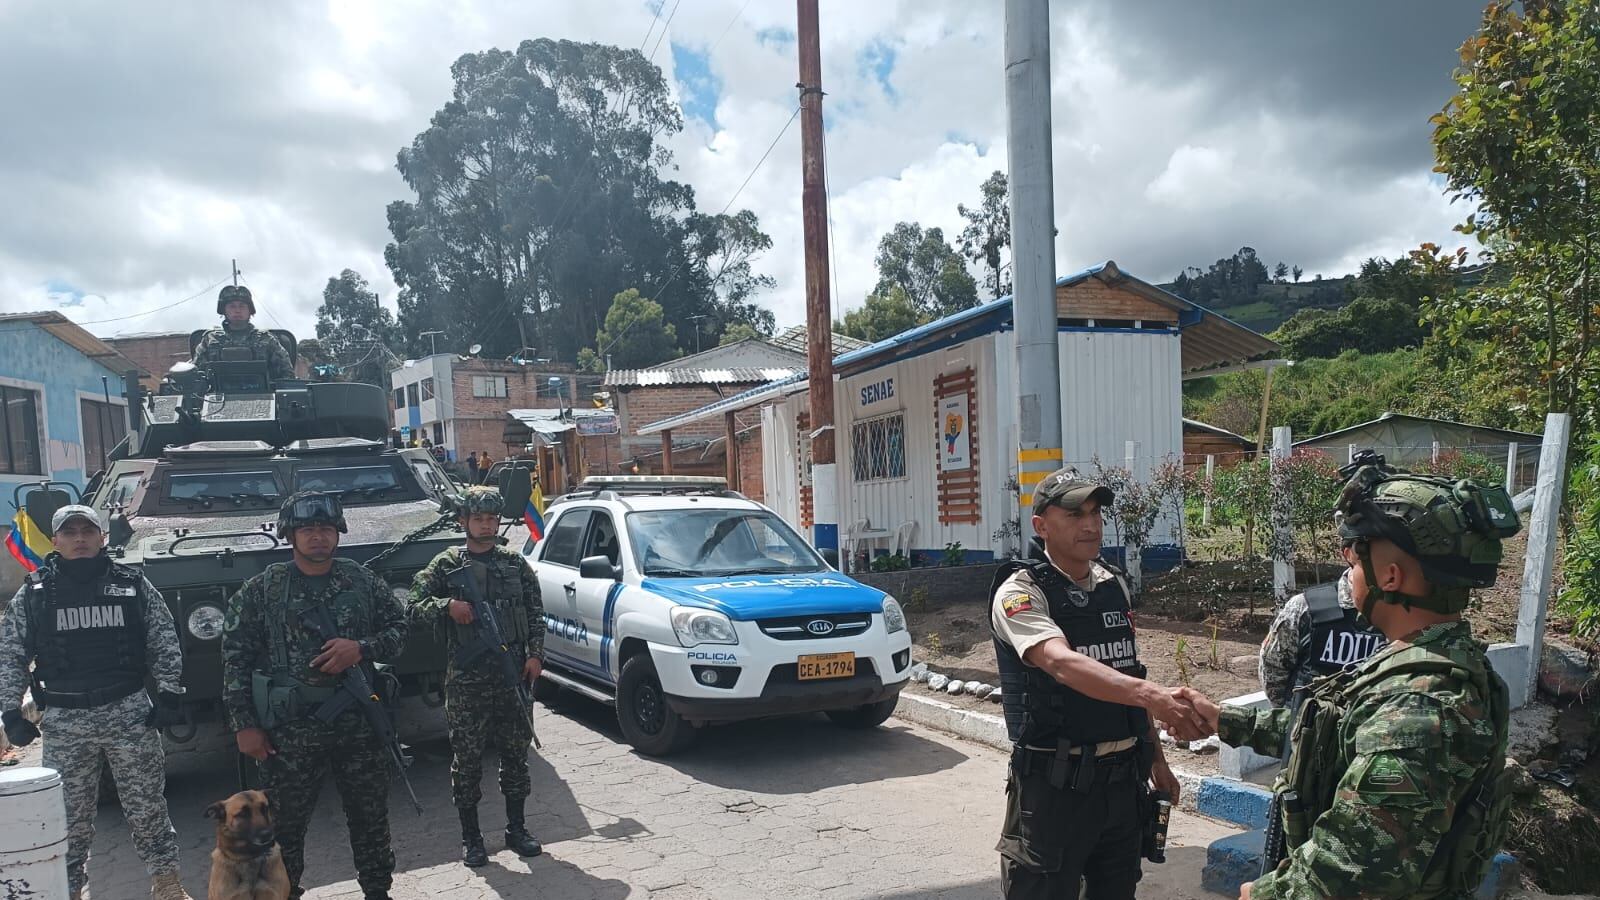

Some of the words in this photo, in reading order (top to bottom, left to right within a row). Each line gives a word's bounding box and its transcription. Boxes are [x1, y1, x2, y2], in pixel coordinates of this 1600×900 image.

[861, 378, 894, 406] SENAE
[56, 605, 125, 631] ADUANA
[687, 652, 737, 661] POLICIA
[800, 660, 853, 677] CEA-1794
